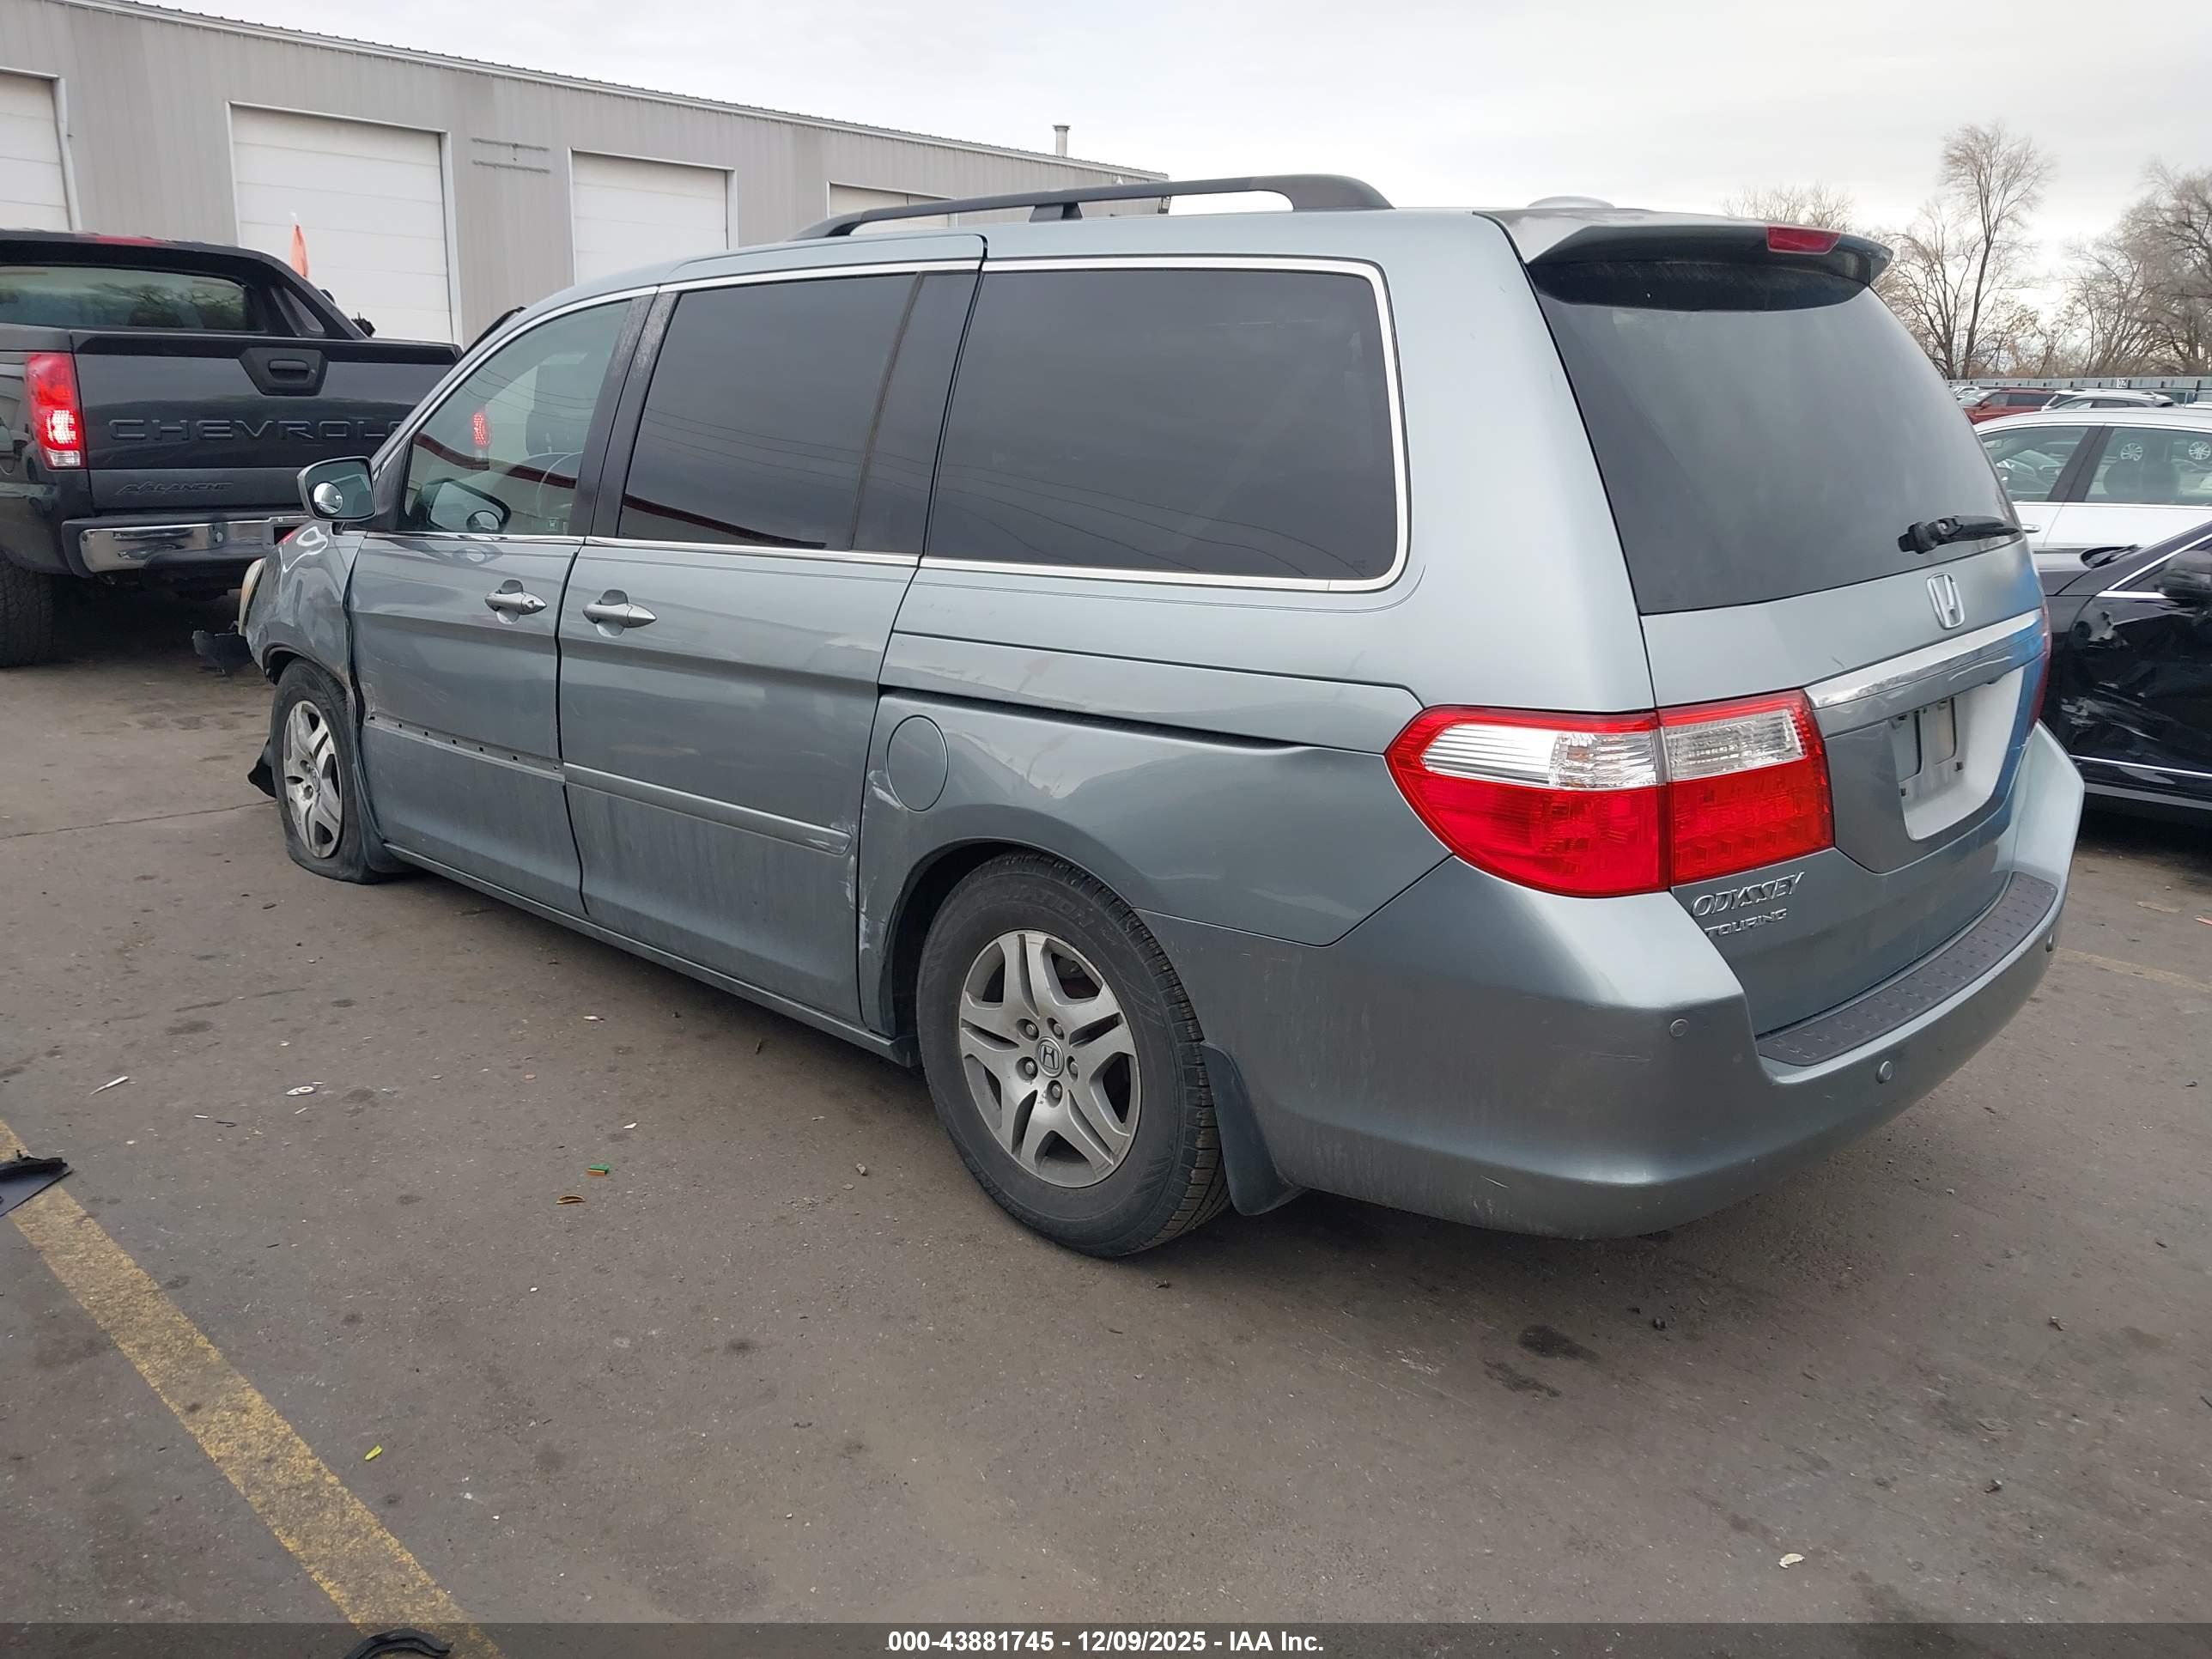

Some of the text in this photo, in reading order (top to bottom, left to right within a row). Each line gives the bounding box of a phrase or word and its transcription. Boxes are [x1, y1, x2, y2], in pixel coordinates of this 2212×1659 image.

[109, 419, 404, 440] CHEVROL
[1691, 871, 1805, 918] ODYSSEY
[1704, 908, 1788, 939] TOURING
